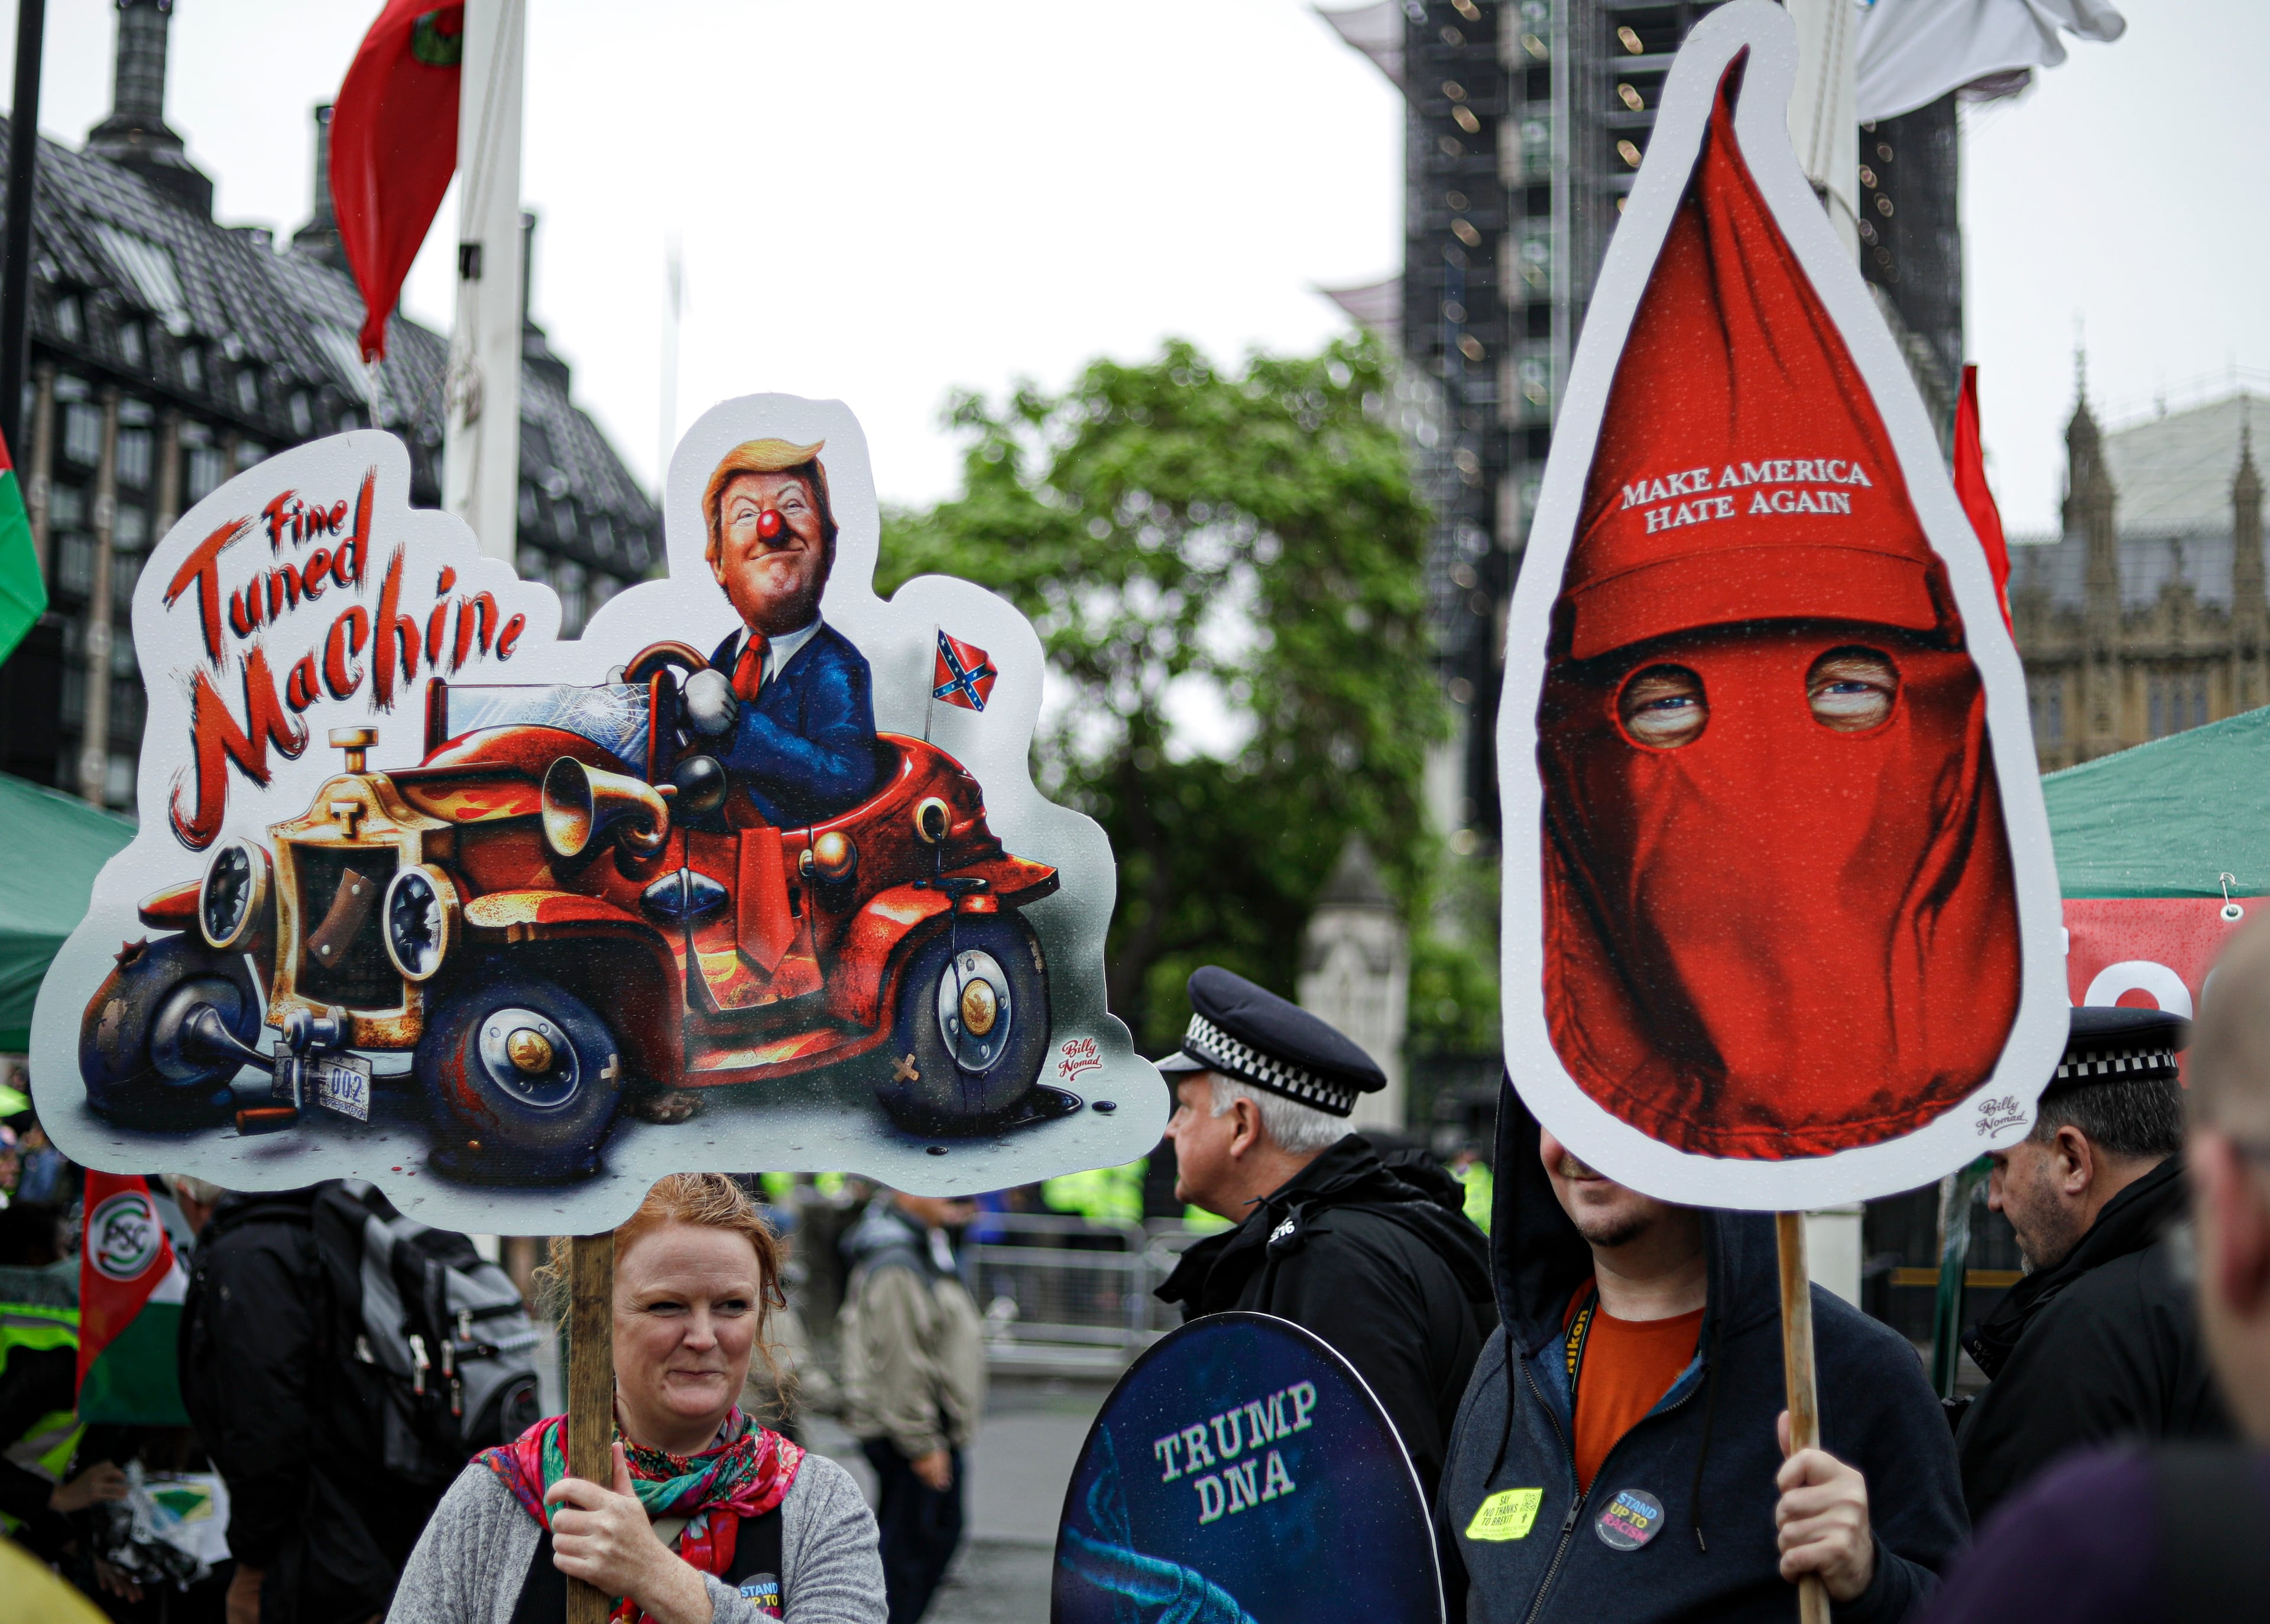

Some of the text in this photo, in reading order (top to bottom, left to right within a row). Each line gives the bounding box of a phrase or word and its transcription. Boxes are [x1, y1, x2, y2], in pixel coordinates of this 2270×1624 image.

[1622, 459, 1873, 510] MAKE AMERICA
[260, 489, 349, 559] Fine
[1645, 491, 1851, 534] HATE AGAIN
[162, 465, 378, 678] Tuned
[1062, 1038, 1097, 1058] Billy
[1058, 1055, 1102, 1081] Nomad
[332, 1068, 362, 1103] 002
[1979, 1096, 2019, 1116] Billy
[1976, 1111, 2028, 1139] Nomad
[1567, 1310, 1589, 1373] Nikon
[1153, 1381, 1317, 1483] TRUMP
[1195, 1450, 1296, 1525] DNA
[1499, 1495, 1511, 1506] SAY
[1483, 1503, 1519, 1517] NO THANKS
[1610, 1502, 1648, 1528] UP TO
[1617, 1493, 1658, 1519] STAND
[1481, 1514, 1513, 1526] TO BREXIT
[1603, 1513, 1649, 1544] RACISM
[741, 1583, 778, 1597] STAND
[742, 1594, 778, 1607] P TO
